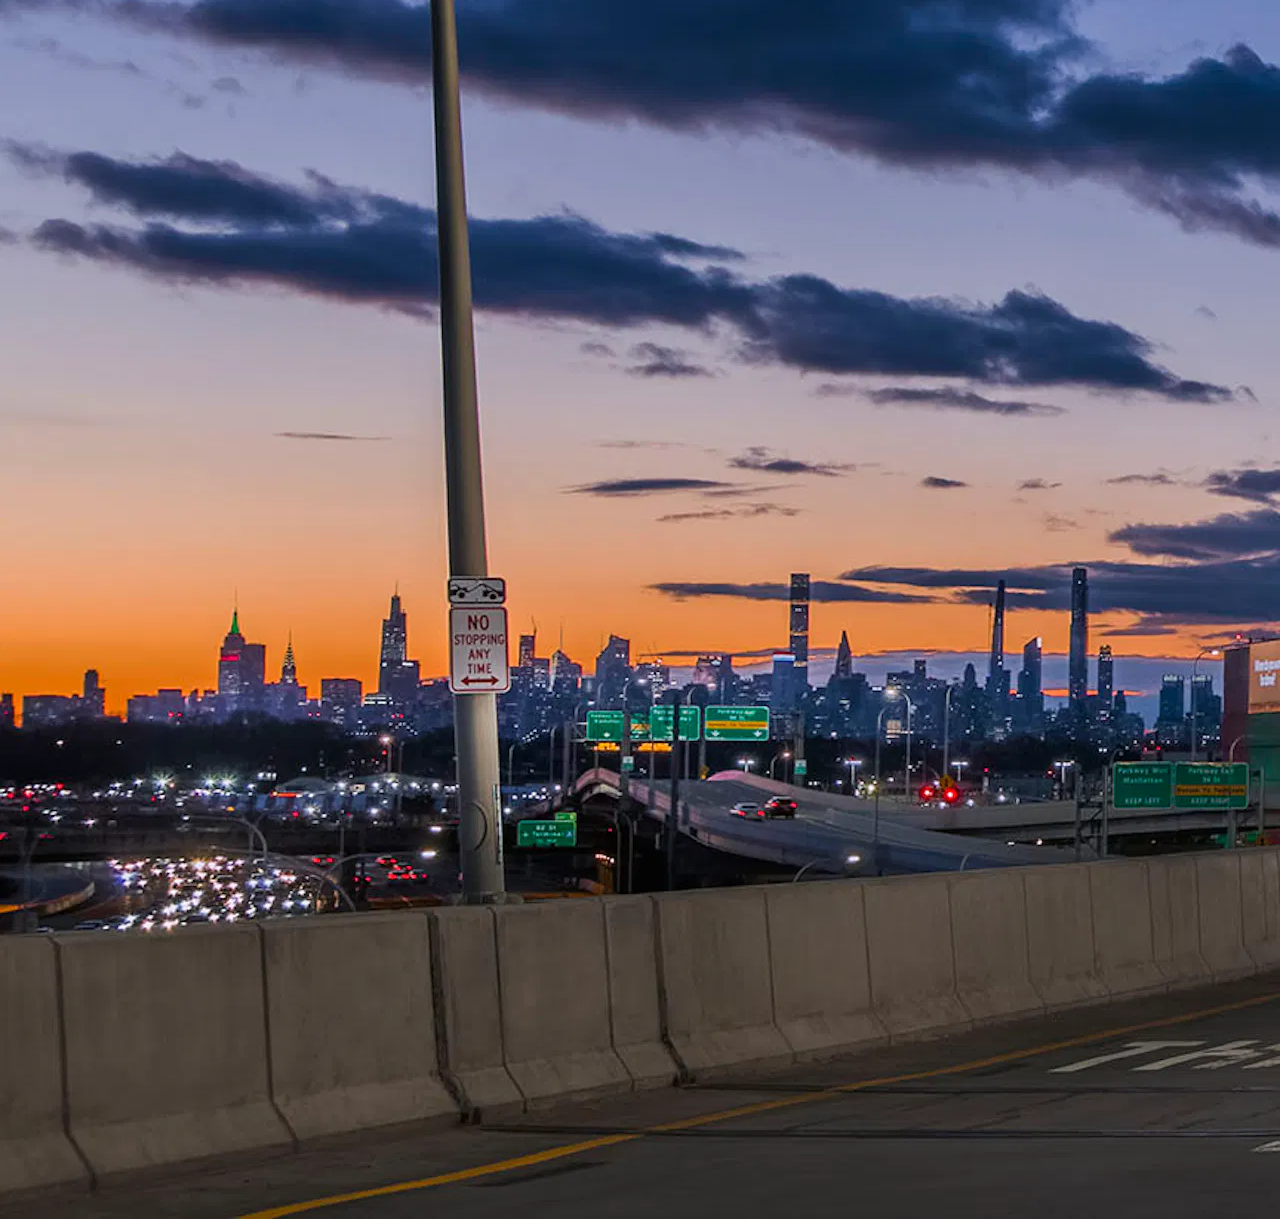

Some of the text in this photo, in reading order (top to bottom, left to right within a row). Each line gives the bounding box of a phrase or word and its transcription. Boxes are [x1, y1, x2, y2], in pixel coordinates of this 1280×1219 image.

[467, 614, 489, 631] NO
[454, 633, 506, 646] STOPPING
[468, 649, 491, 660] ANY
[467, 663, 493, 674] TIME
